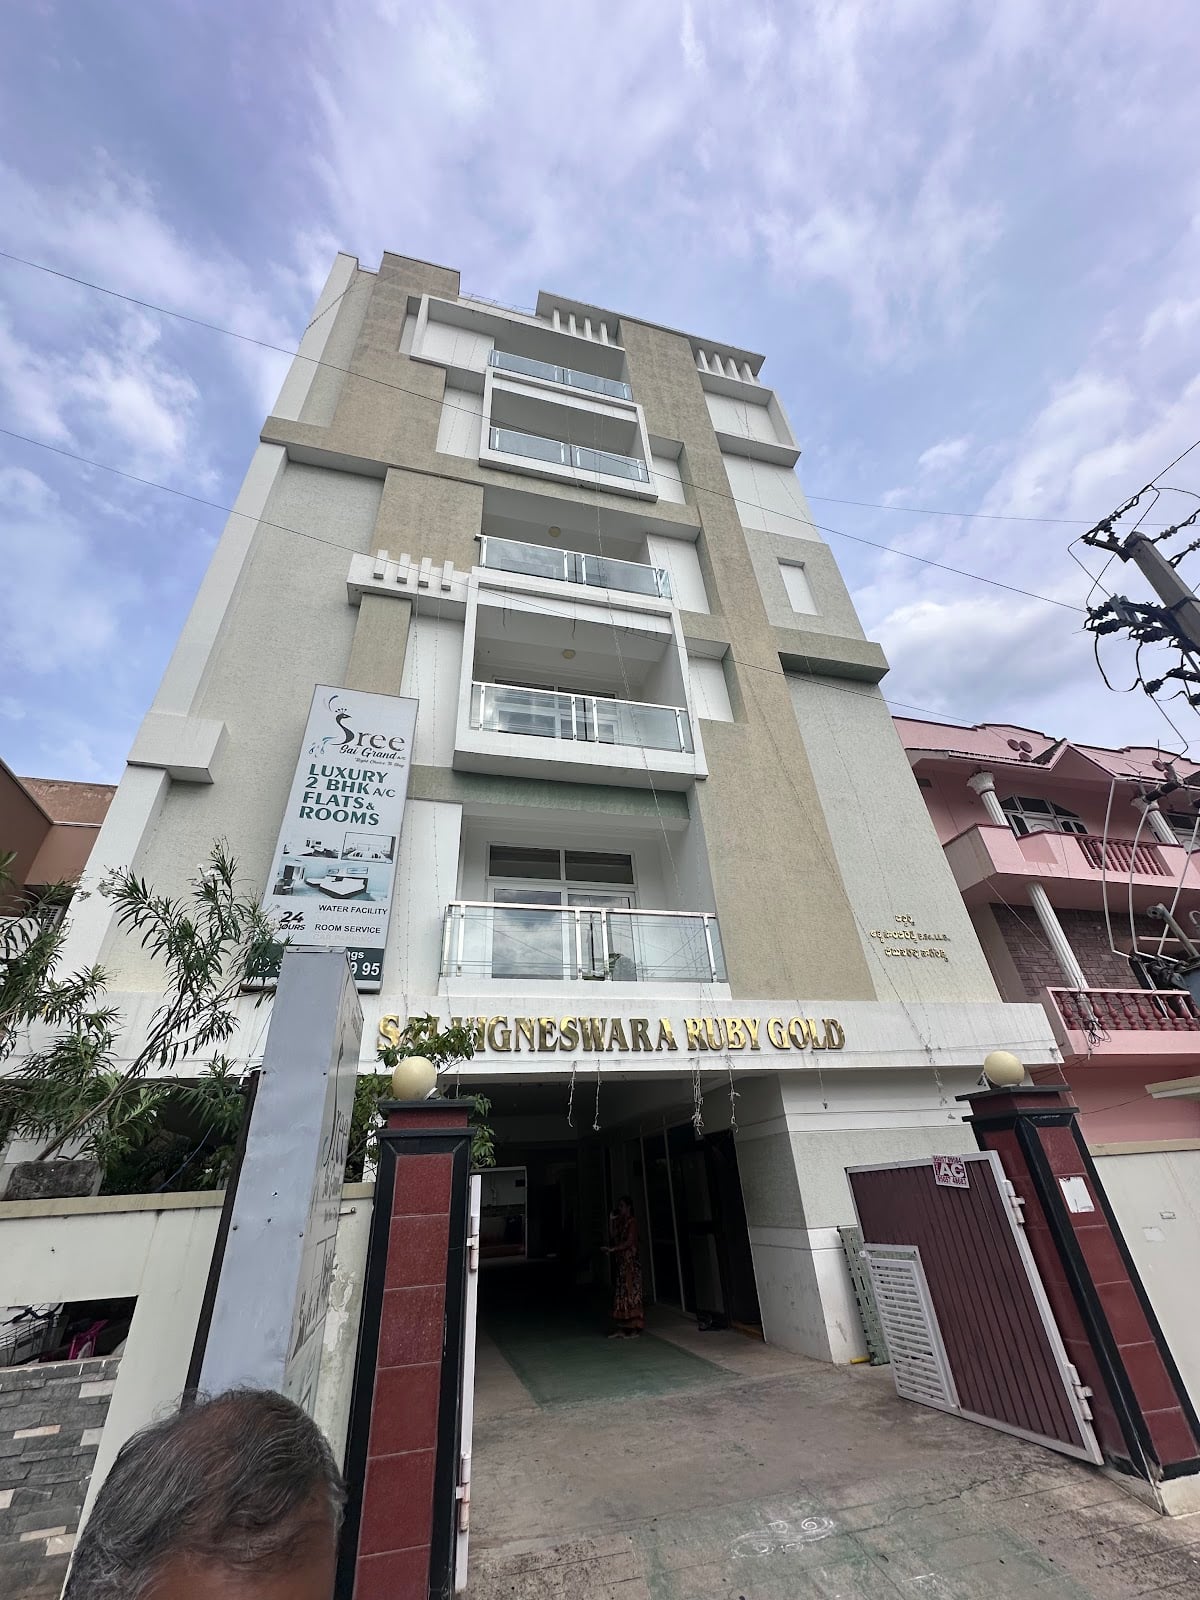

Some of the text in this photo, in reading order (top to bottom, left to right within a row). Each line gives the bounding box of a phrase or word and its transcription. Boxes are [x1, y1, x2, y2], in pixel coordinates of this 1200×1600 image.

[333, 712, 405, 751] Sree
[339, 744, 358, 755] Sai
[361, 747, 397, 760] Grand
[309, 763, 388, 784] LUXURY
[305, 776, 396, 798] 2 BHK A/C
[302, 791, 375, 811] FLATS &
[300, 805, 380, 826] ROOMS
[280, 911, 304, 924] 24
[318, 904, 388, 915] WATER FACILITY
[314, 923, 381, 934] ROOM SERVICE
[361, 962, 380, 976] 95
[684, 1017, 761, 1050] RUBY
[767, 1017, 845, 1050] GOLD
[940, 1163, 965, 1178] AC
